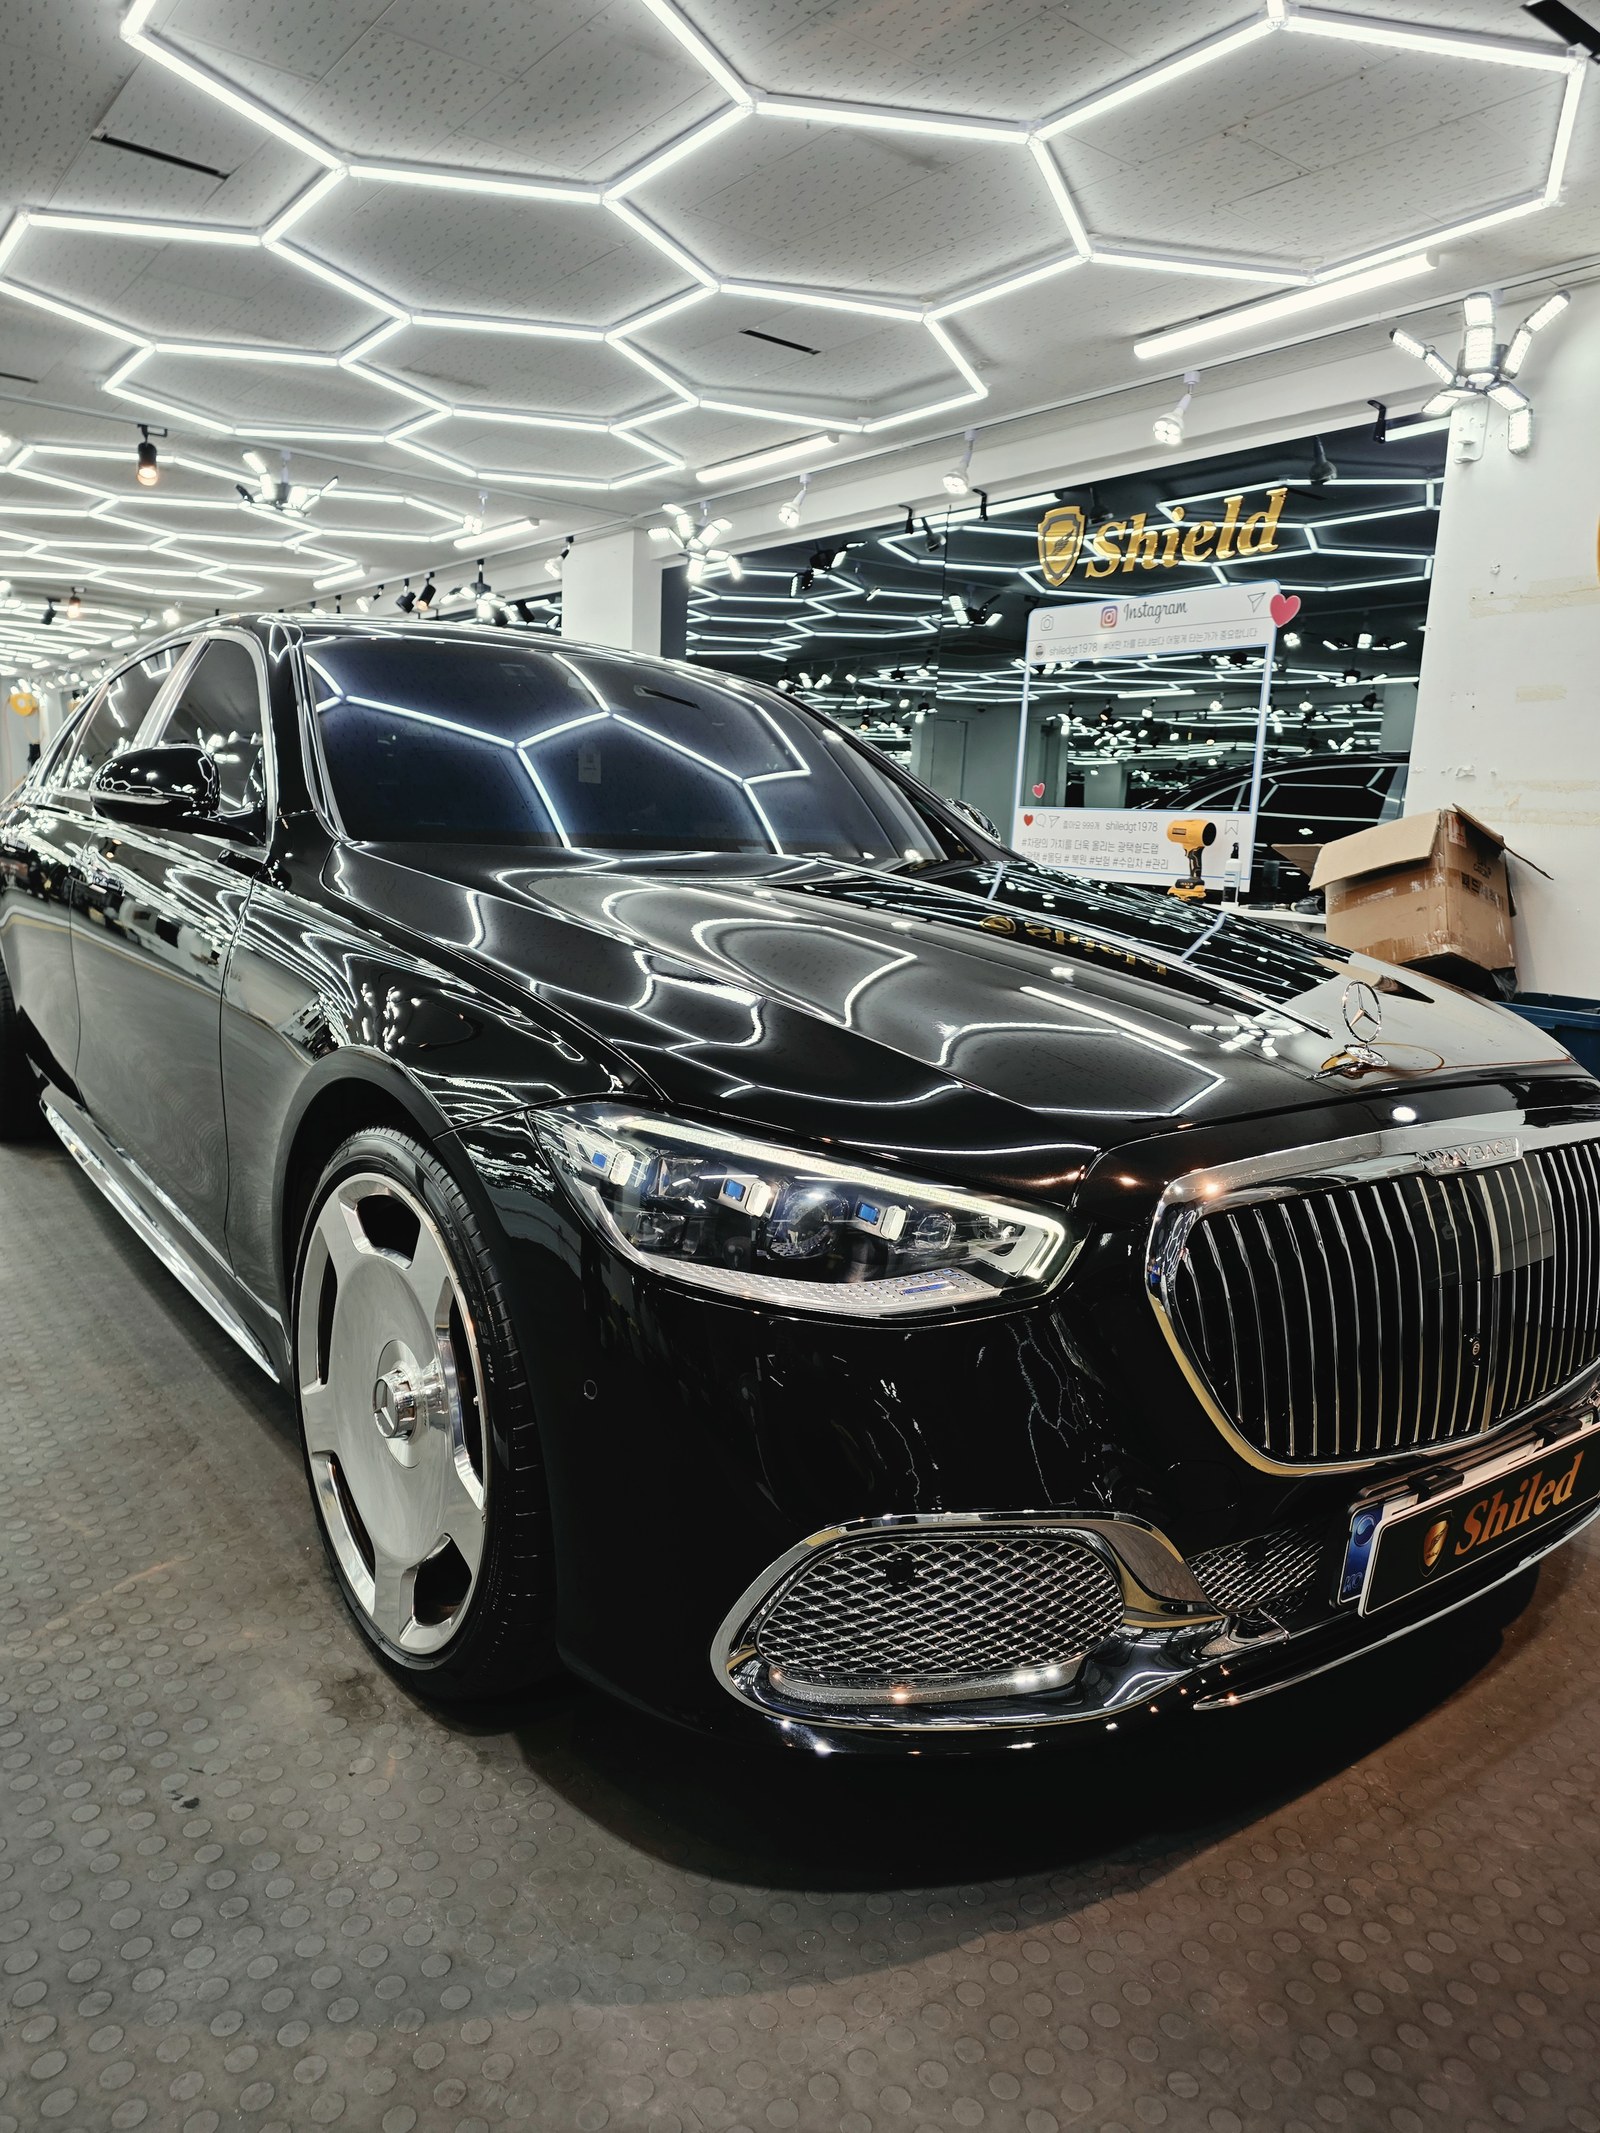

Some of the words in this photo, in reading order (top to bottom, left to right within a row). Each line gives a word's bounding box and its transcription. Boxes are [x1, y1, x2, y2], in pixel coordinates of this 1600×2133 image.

[1085, 487, 1288, 578] Shield
[1123, 599, 1188, 625] Instagram
[1105, 821, 1158, 834] shiledgt1978
[1021, 838, 1048, 849] #차량의
[1050, 838, 1072, 850] 가치를
[1074, 839, 1090, 851] 더욱
[1092, 840, 1115, 852] 올리는
[1112, 857, 1143, 868] #수입차
[1145, 858, 1168, 870] #관리
[1454, 1450, 1584, 1556] Shiled
